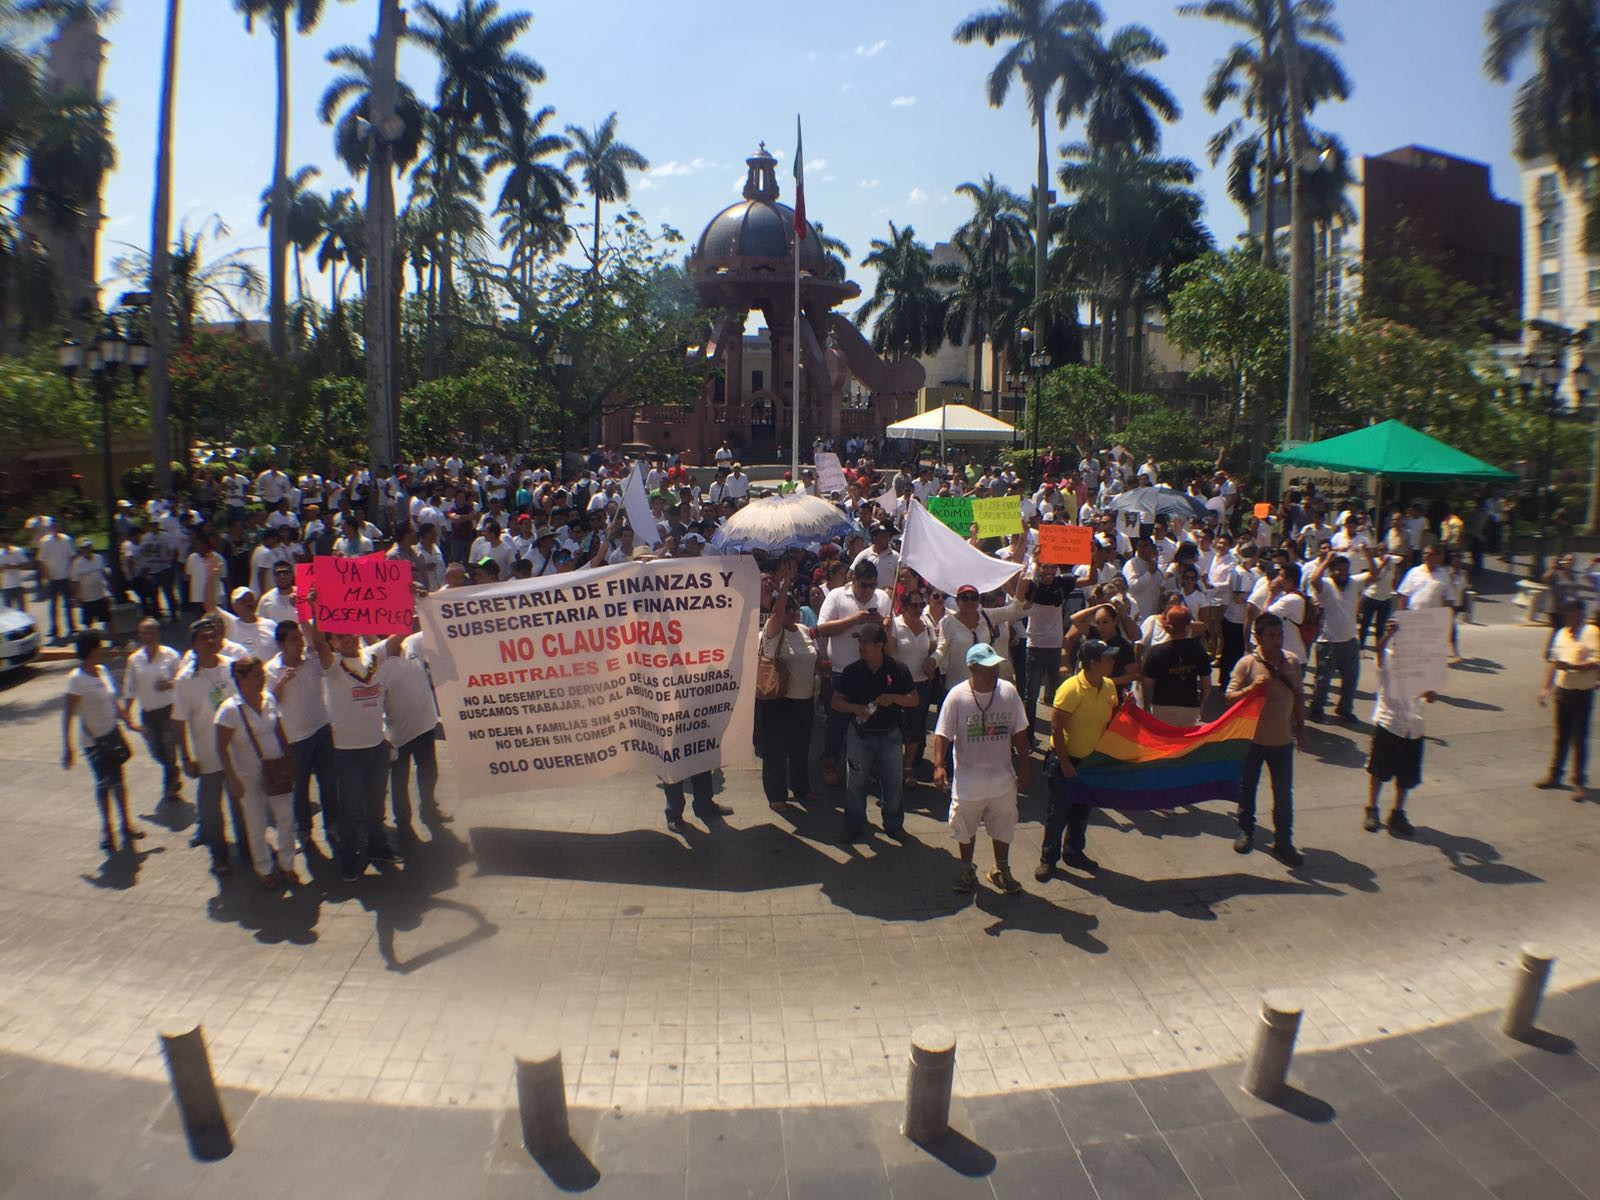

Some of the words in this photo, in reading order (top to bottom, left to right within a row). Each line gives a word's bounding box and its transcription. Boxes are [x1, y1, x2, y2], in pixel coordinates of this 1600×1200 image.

[941, 497, 966, 508] SOLO
[334, 559, 361, 584] YA
[375, 562, 400, 583] NO
[344, 586, 388, 602] MAS
[441, 589, 568, 619] SECRETARIA
[572, 583, 602, 600] DE
[607, 573, 712, 596] FINANZAS
[720, 571, 734, 587] Y
[319, 605, 413, 627] DESEMPLEO
[446, 604, 599, 638] SUBSECRETARIA
[605, 600, 628, 617] DE
[633, 594, 733, 613] FINANZAS:
[498, 637, 534, 663] NO
[541, 619, 683, 657] CLAUSURAS
[467, 660, 600, 688] ARBITRALES
[606, 657, 621, 672] E
[626, 648, 726, 669] ILEGALES
[459, 705, 520, 721] BUSCAMOS
[521, 699, 585, 714] TRABAJAR,
[588, 695, 605, 708] NO
[609, 691, 623, 703] AL
[625, 686, 654, 700] ABUSO
[656, 692, 671, 701] DE
[674, 681, 740, 700] AUTORIDAD.
[464, 696, 480, 707] NO
[483, 695, 497, 705] AL
[498, 687, 565, 703] DESEMPLEO
[568, 676, 626, 696] DERIVADO
[629, 673, 642, 683] DE
[662, 669, 733, 688] CLAUSURAS,
[469, 729, 485, 740] NO
[488, 726, 523, 738] DEJEN
[526, 725, 534, 735] A
[536, 719, 588, 734] FAMILIAS
[591, 714, 611, 727] SIN
[614, 705, 660, 723] SUSTENTO
[662, 710, 690, 723] PARA
[693, 701, 734, 717] COMER,
[496, 739, 512, 750] NO
[515, 736, 550, 748] DEJEN
[552, 734, 572, 745] SIN
[575, 725, 616, 742] COMER
[618, 721, 627, 731] A
[629, 718, 673, 738] NUESTROS
[675, 719, 711, 735] HIJOS.
[489, 759, 529, 775] SOLO
[533, 745, 618, 770] QUEREMOS
[683, 737, 720, 758] BIEN.
